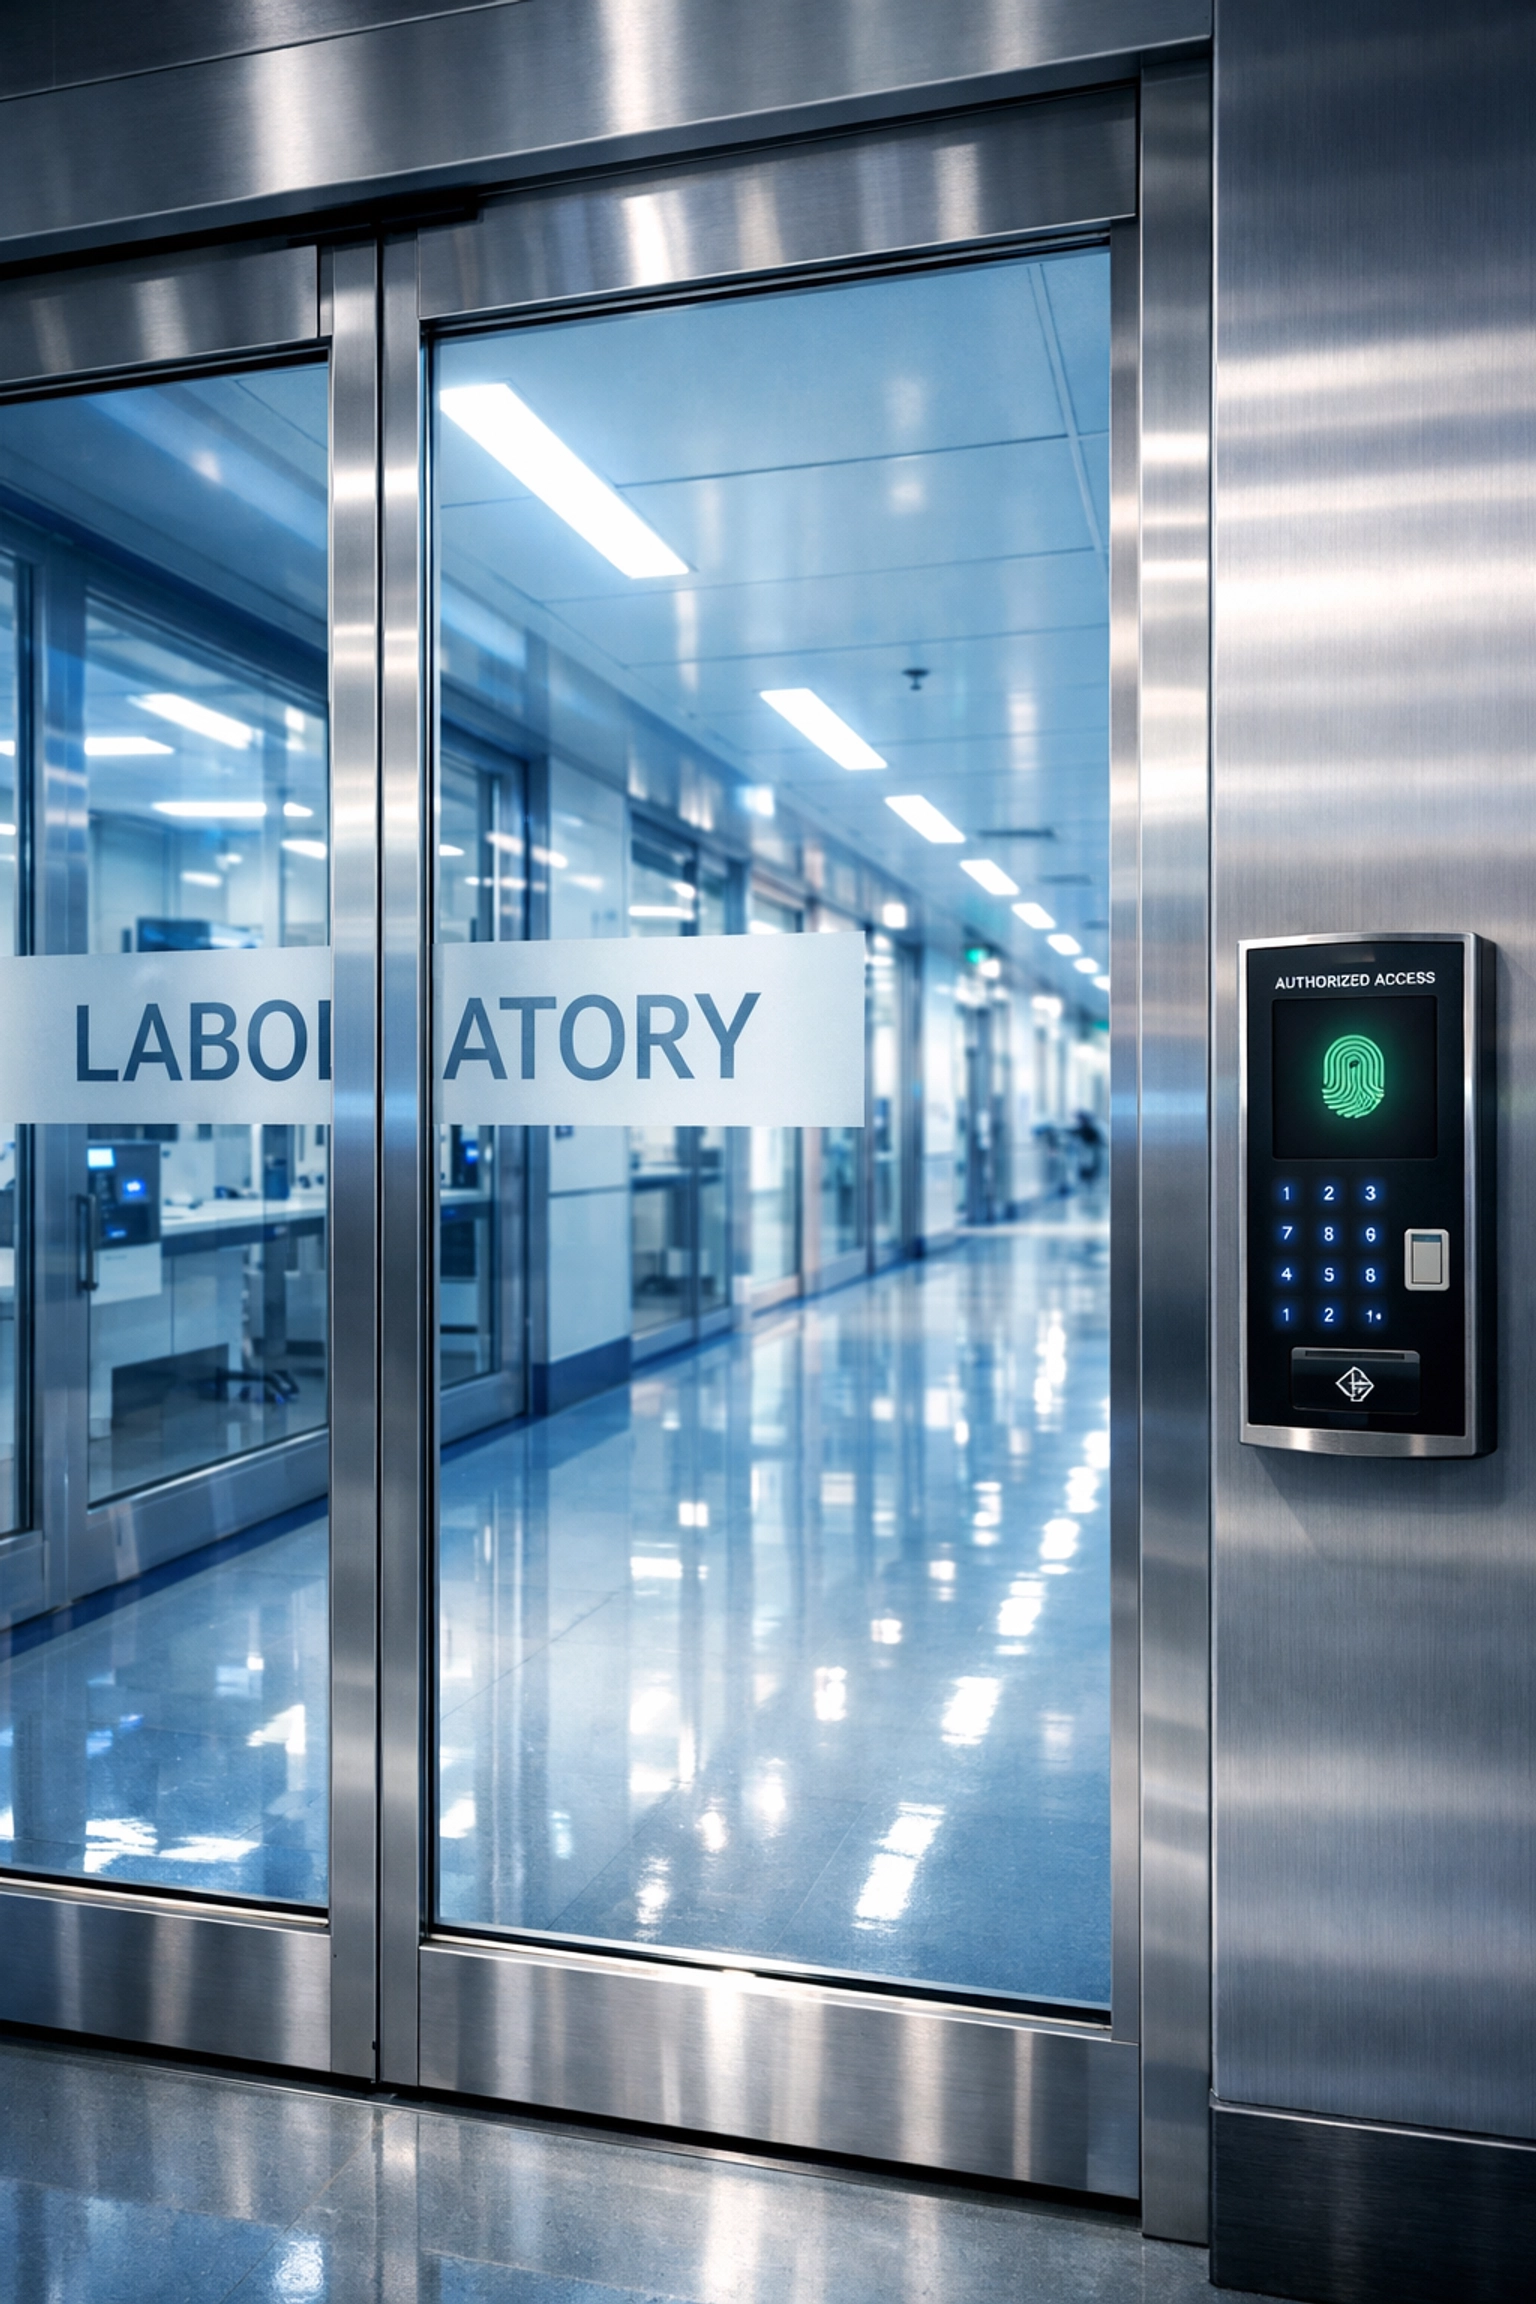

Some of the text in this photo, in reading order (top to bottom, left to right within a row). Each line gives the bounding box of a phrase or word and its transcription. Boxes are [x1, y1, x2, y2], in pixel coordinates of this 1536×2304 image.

[1275, 971, 1436, 990] AUTHORIZED ACCESS
[1283, 1186, 1377, 1201] 1 2 3
[1282, 1226, 1293, 1240] 7
[1323, 1227, 1335, 1242] 8
[1281, 1267, 1293, 1281] 4
[1365, 1267, 1377, 1283] 8
[1282, 1308, 1289, 1322] 1
[1324, 1308, 1334, 1323] 2
